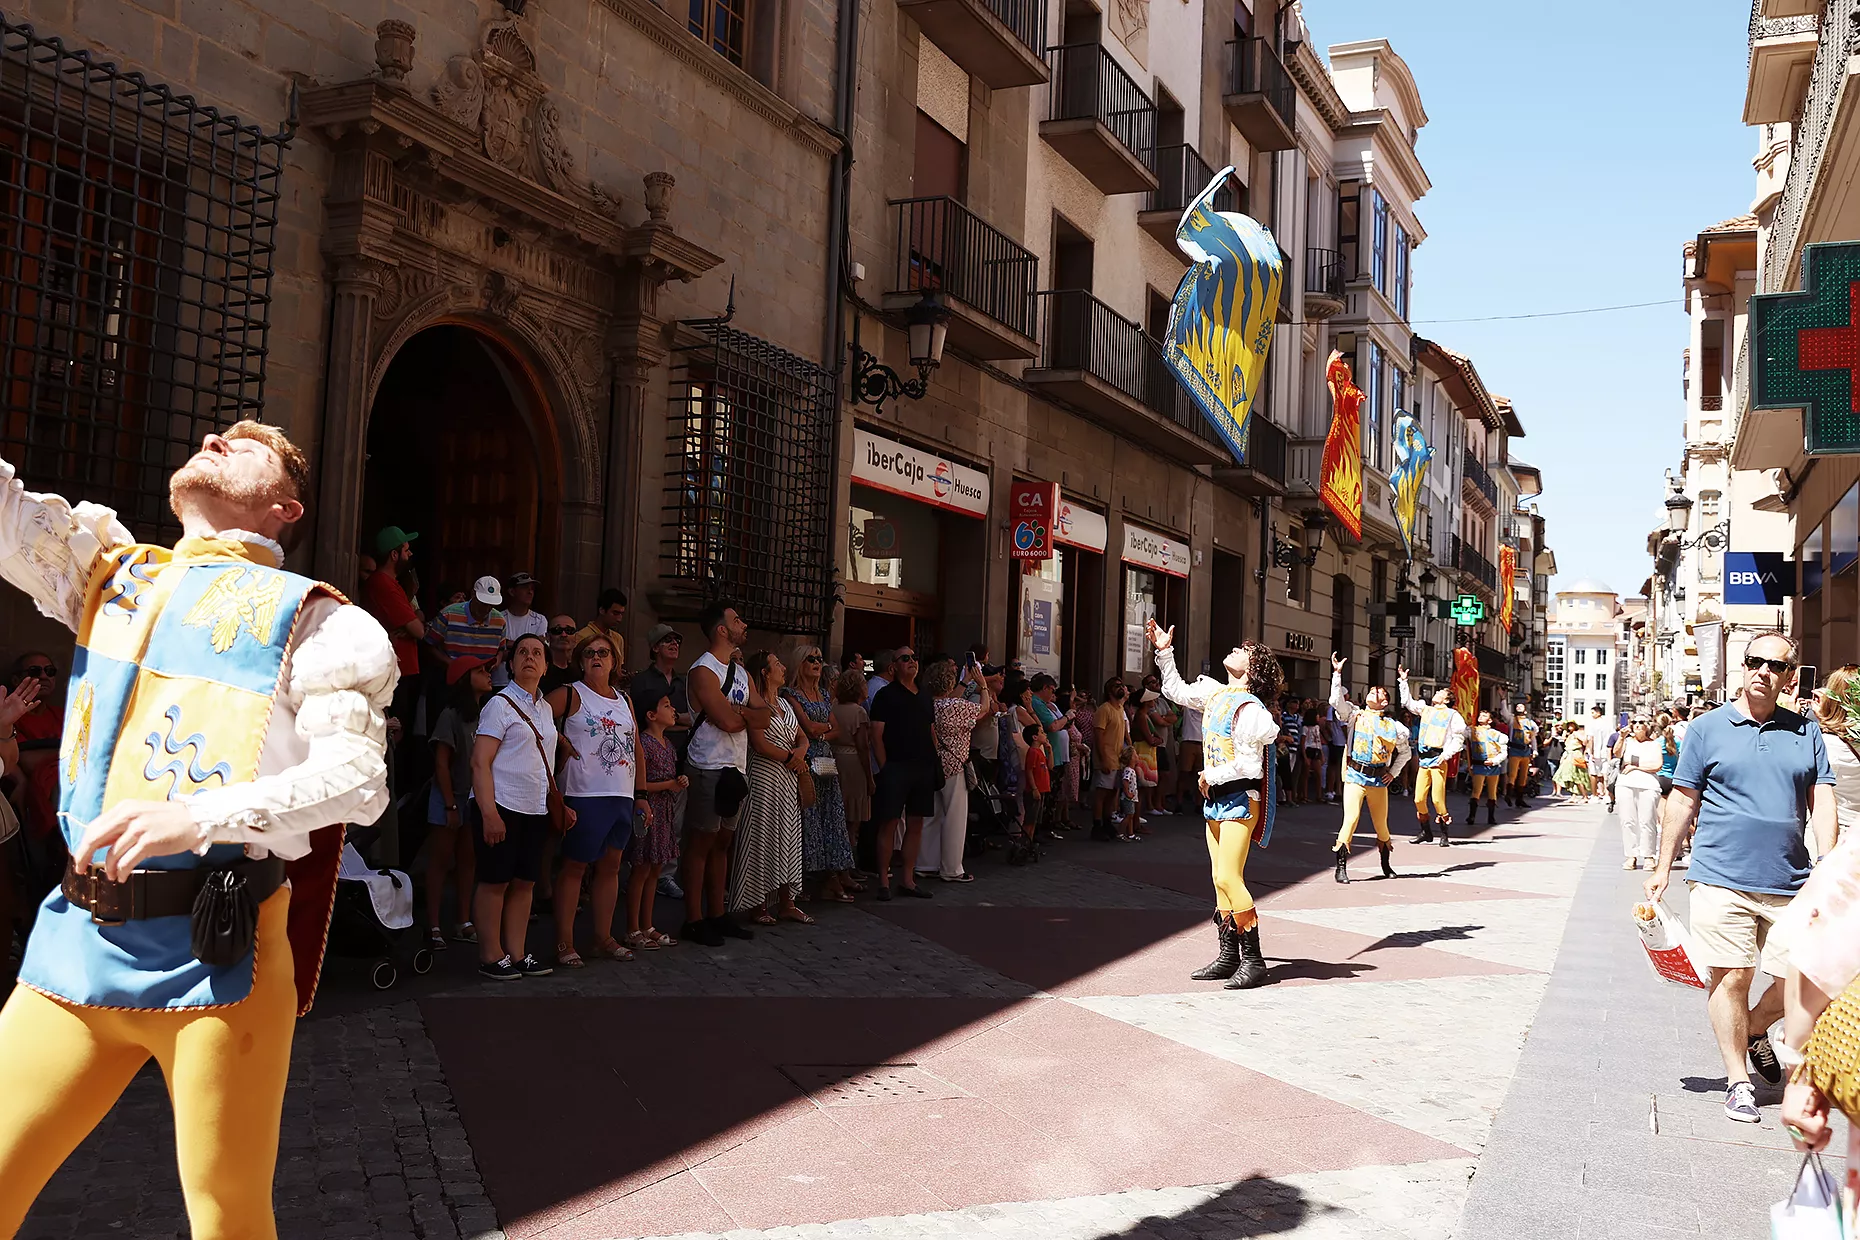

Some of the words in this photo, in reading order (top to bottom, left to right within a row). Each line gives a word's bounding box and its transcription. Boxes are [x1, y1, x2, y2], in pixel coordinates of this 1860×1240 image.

[867, 441, 924, 485] iberCaja
[954, 478, 982, 500] Huesca
[1018, 493, 1044, 507] CA
[1130, 532, 1158, 559] iberCaja
[1171, 550, 1187, 565] Huesca
[1729, 571, 1778, 585] BBVA
[1286, 632, 1315, 652] PRADO
